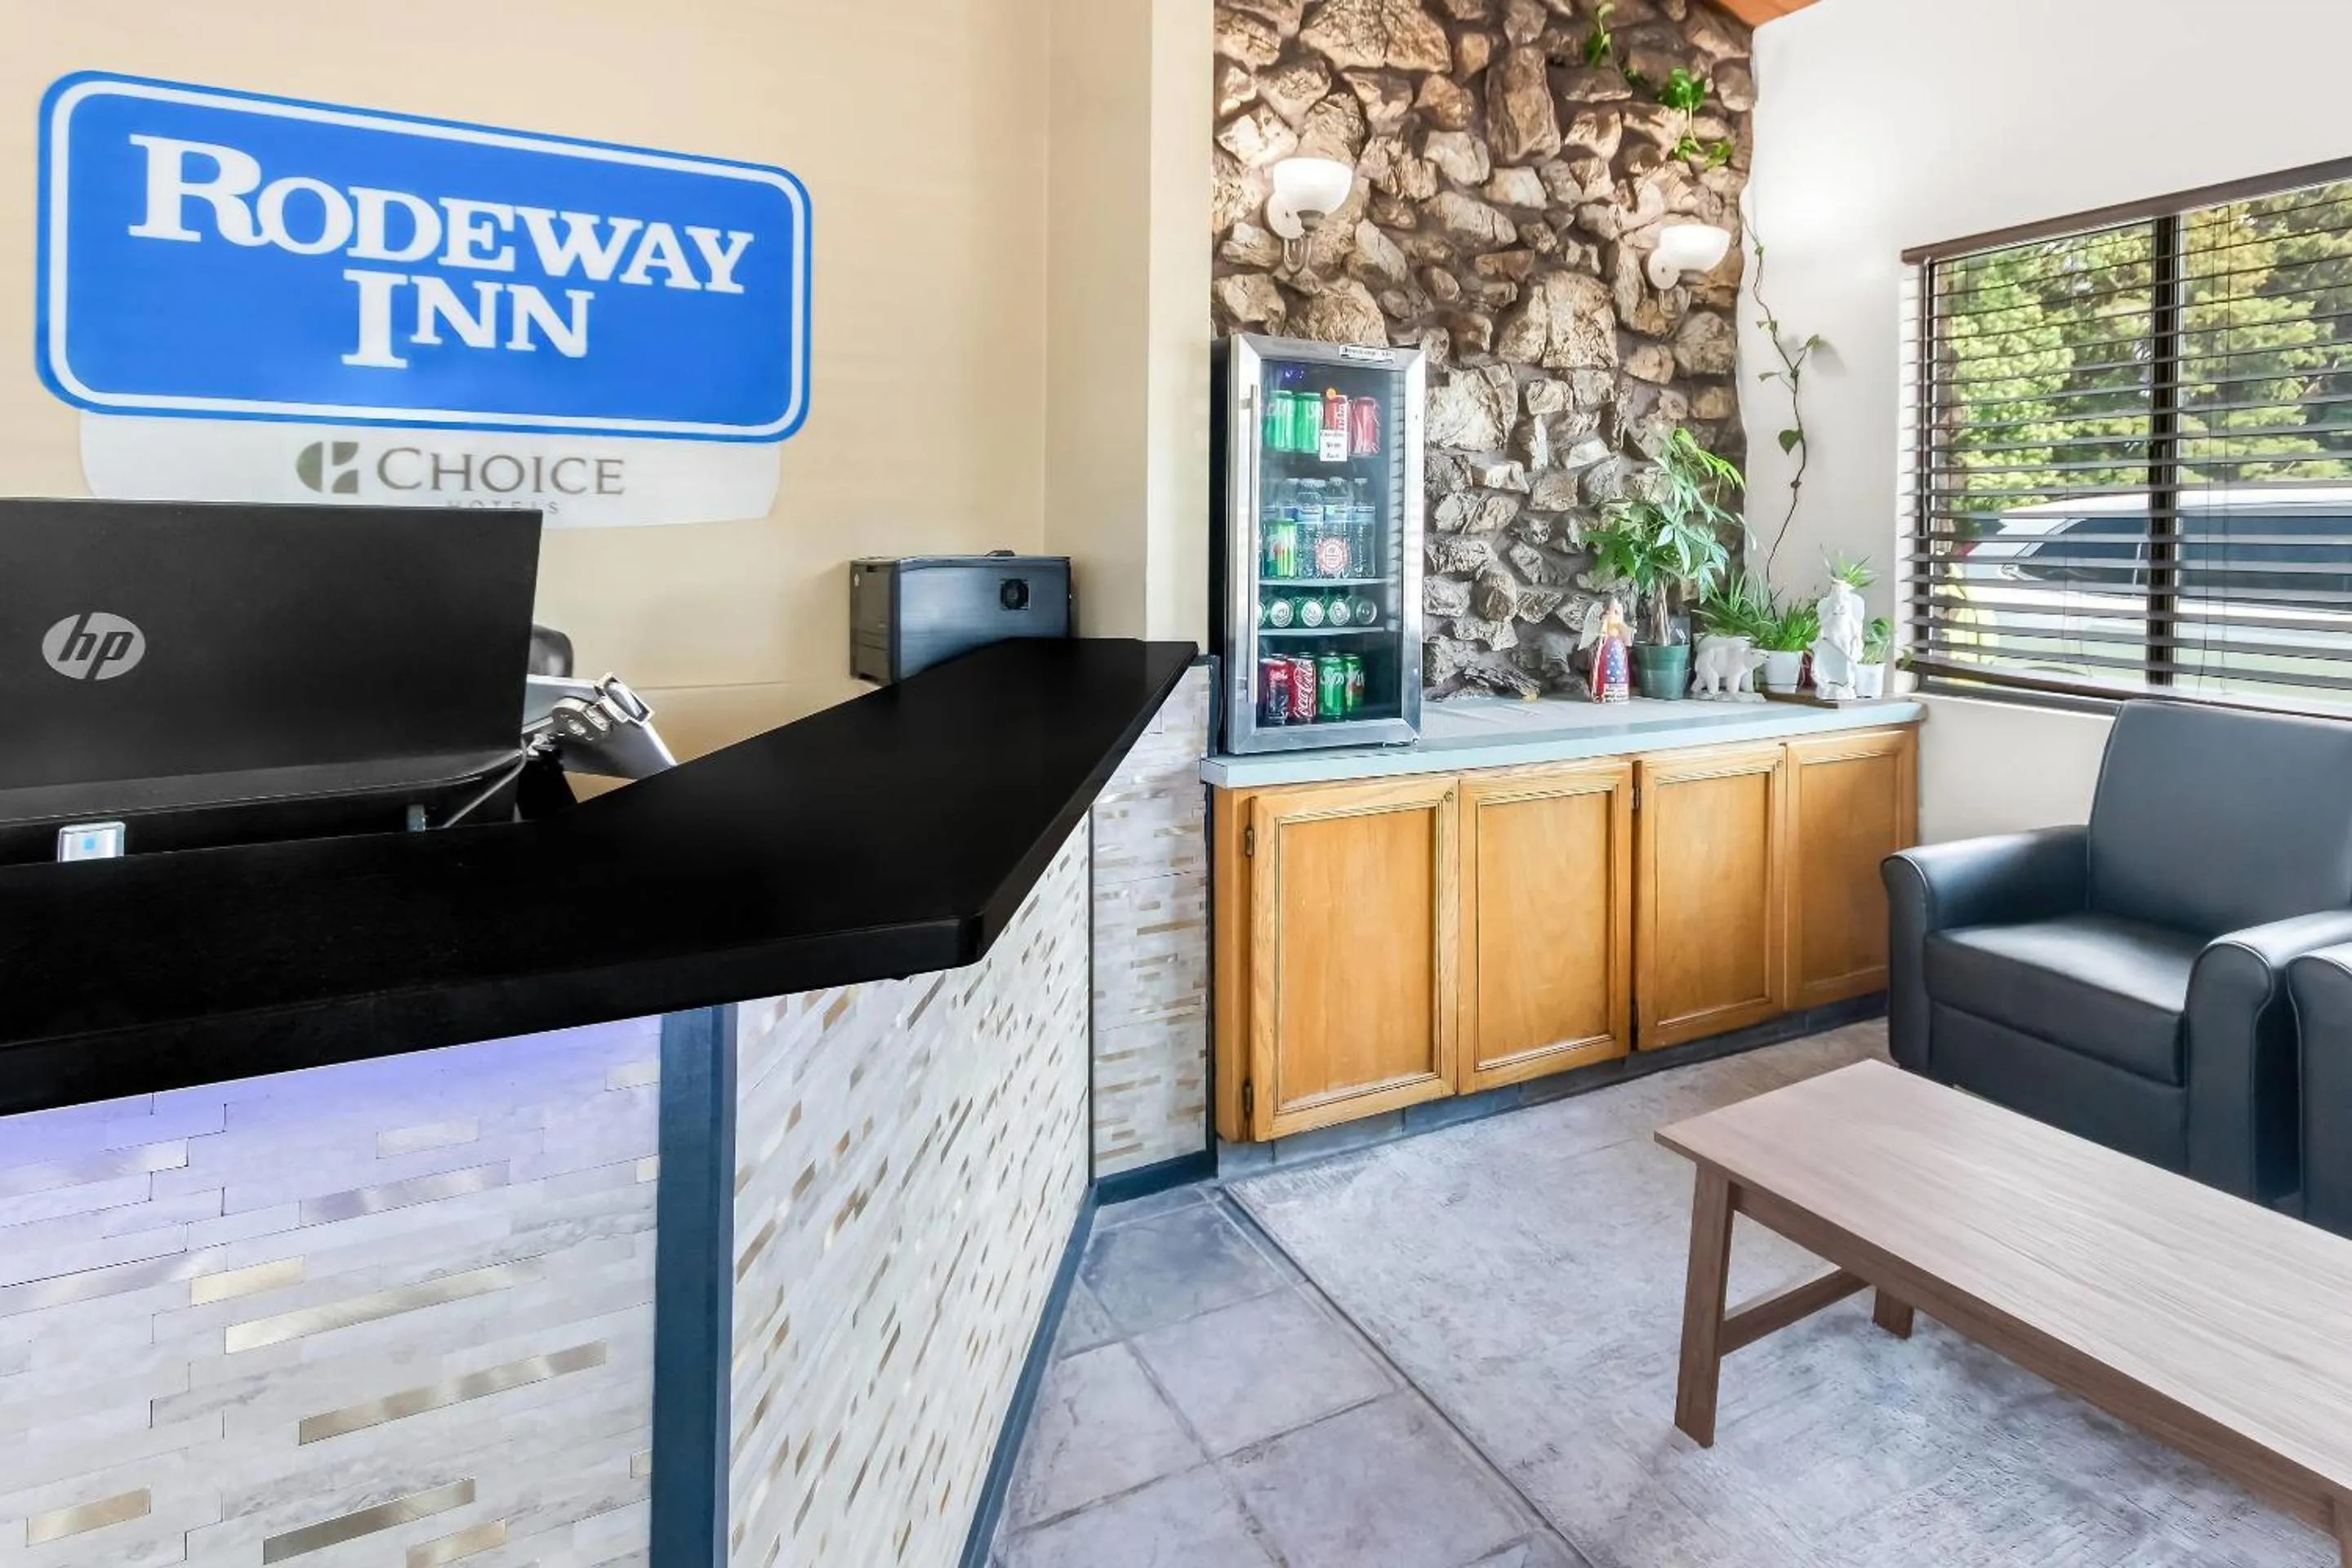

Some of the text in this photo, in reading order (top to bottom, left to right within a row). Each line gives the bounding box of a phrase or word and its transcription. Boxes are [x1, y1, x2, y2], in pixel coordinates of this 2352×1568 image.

[128, 133, 755, 294] RODEWAY
[341, 269, 595, 368] INN
[377, 447, 626, 495] CHOICE
[57, 612, 136, 679] hp
